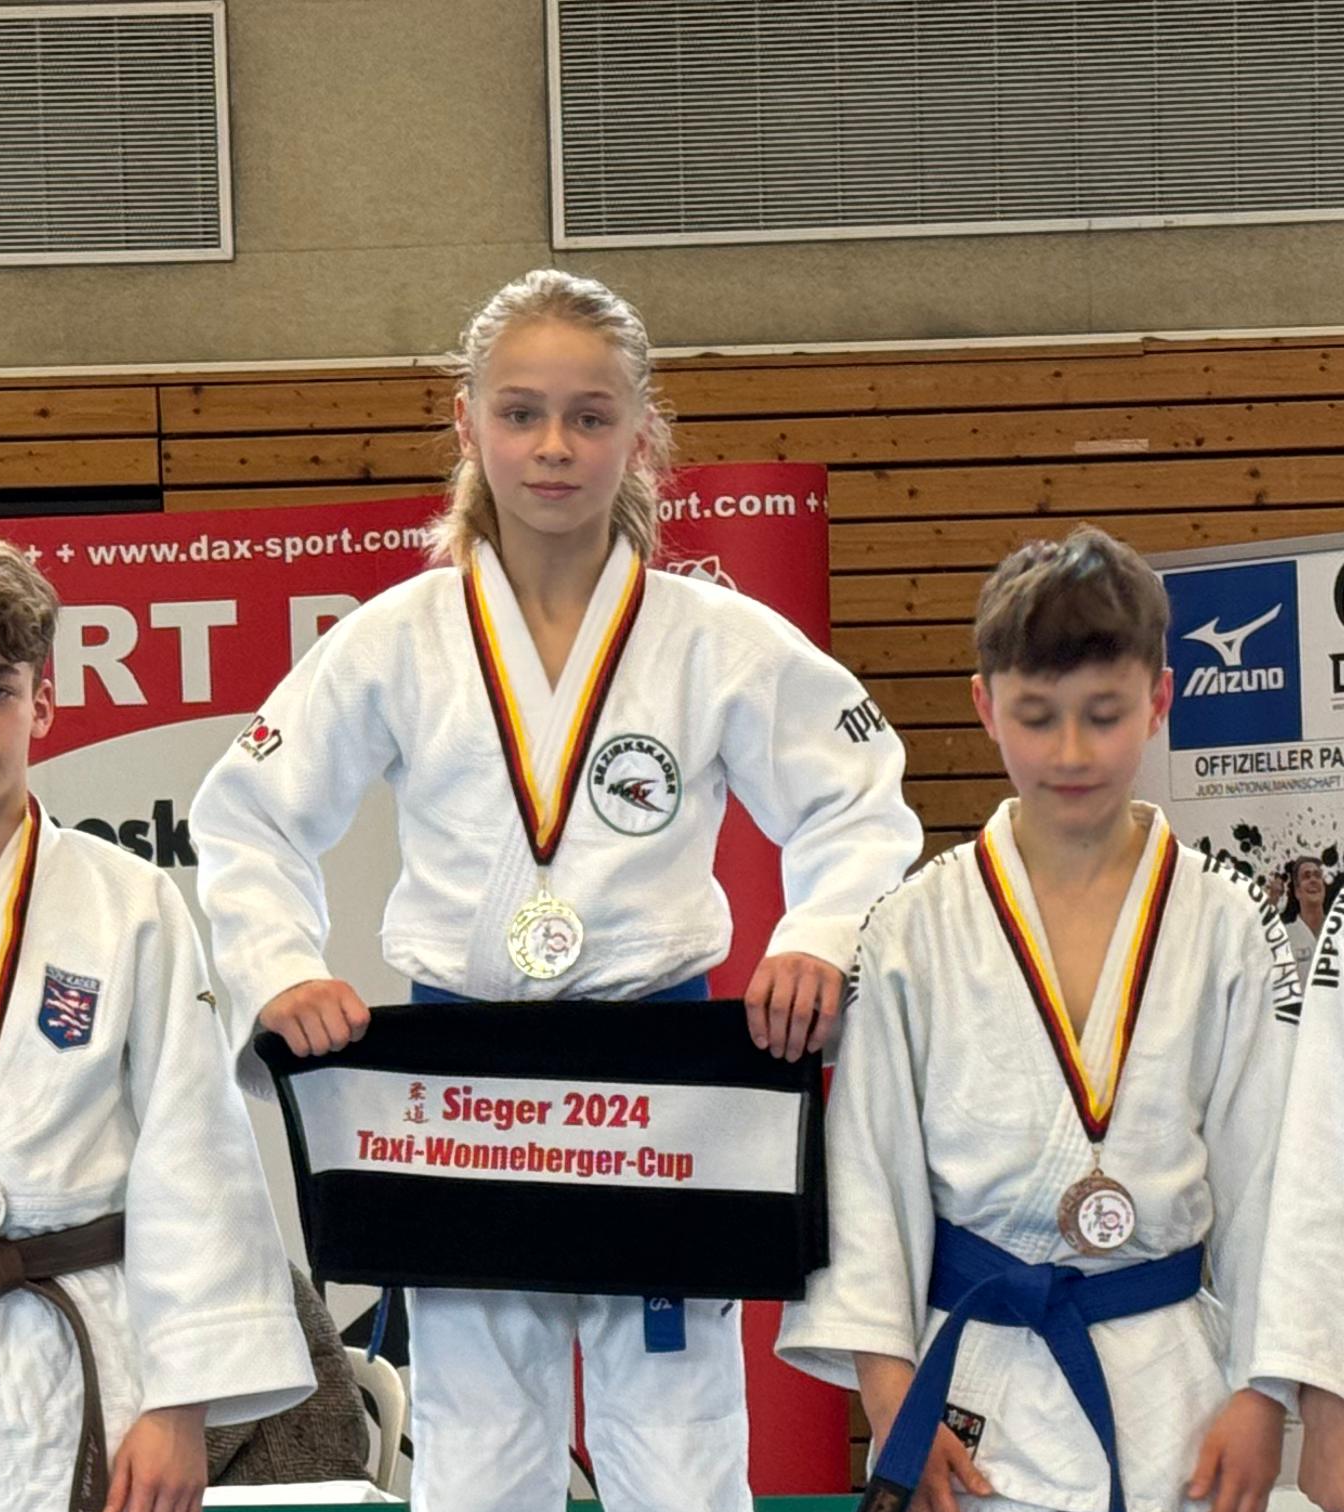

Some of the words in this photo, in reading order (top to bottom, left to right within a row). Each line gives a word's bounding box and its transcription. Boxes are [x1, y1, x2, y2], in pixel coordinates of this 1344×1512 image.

[659, 491, 797, 522] ort.com
[1195, 748, 1313, 778] OFFIZIELLER
[441, 1085, 553, 1131] Sieger
[562, 1092, 651, 1129] 2024
[357, 1130, 694, 1182] Taxi-Wonneberger-Cup
